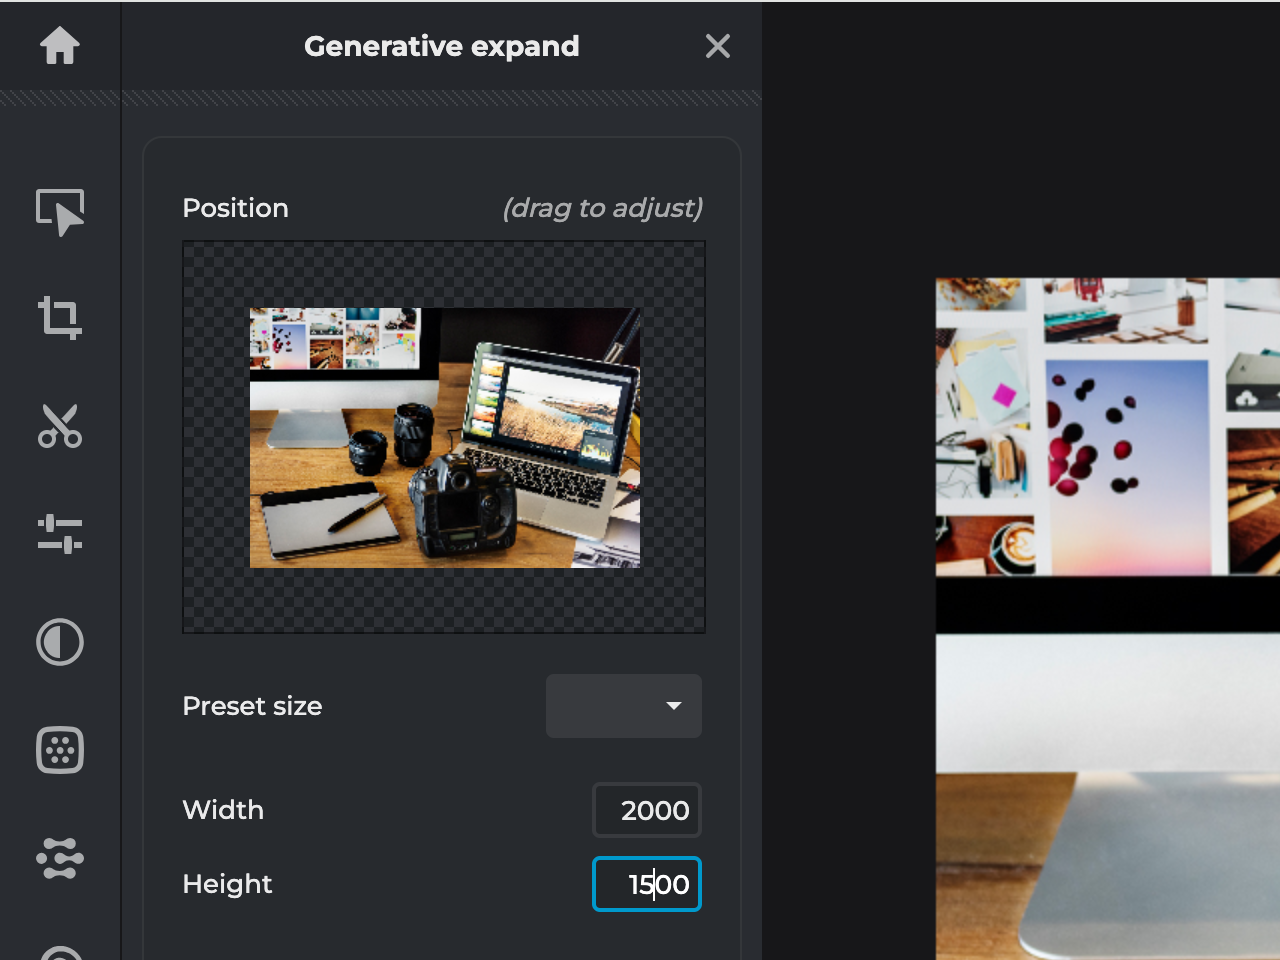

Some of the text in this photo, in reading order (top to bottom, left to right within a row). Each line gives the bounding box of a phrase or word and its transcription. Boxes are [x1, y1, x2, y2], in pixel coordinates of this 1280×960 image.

[305, 33, 579, 62] Generative expand
[184, 197, 288, 218] Position
[504, 197, 703, 222] (drag to adjust)
[184, 695, 322, 716] Preset size
[182, 799, 263, 819] Width
[621, 800, 689, 821] 2000
[184, 873, 272, 899] Height
[629, 874, 689, 895] 1500
